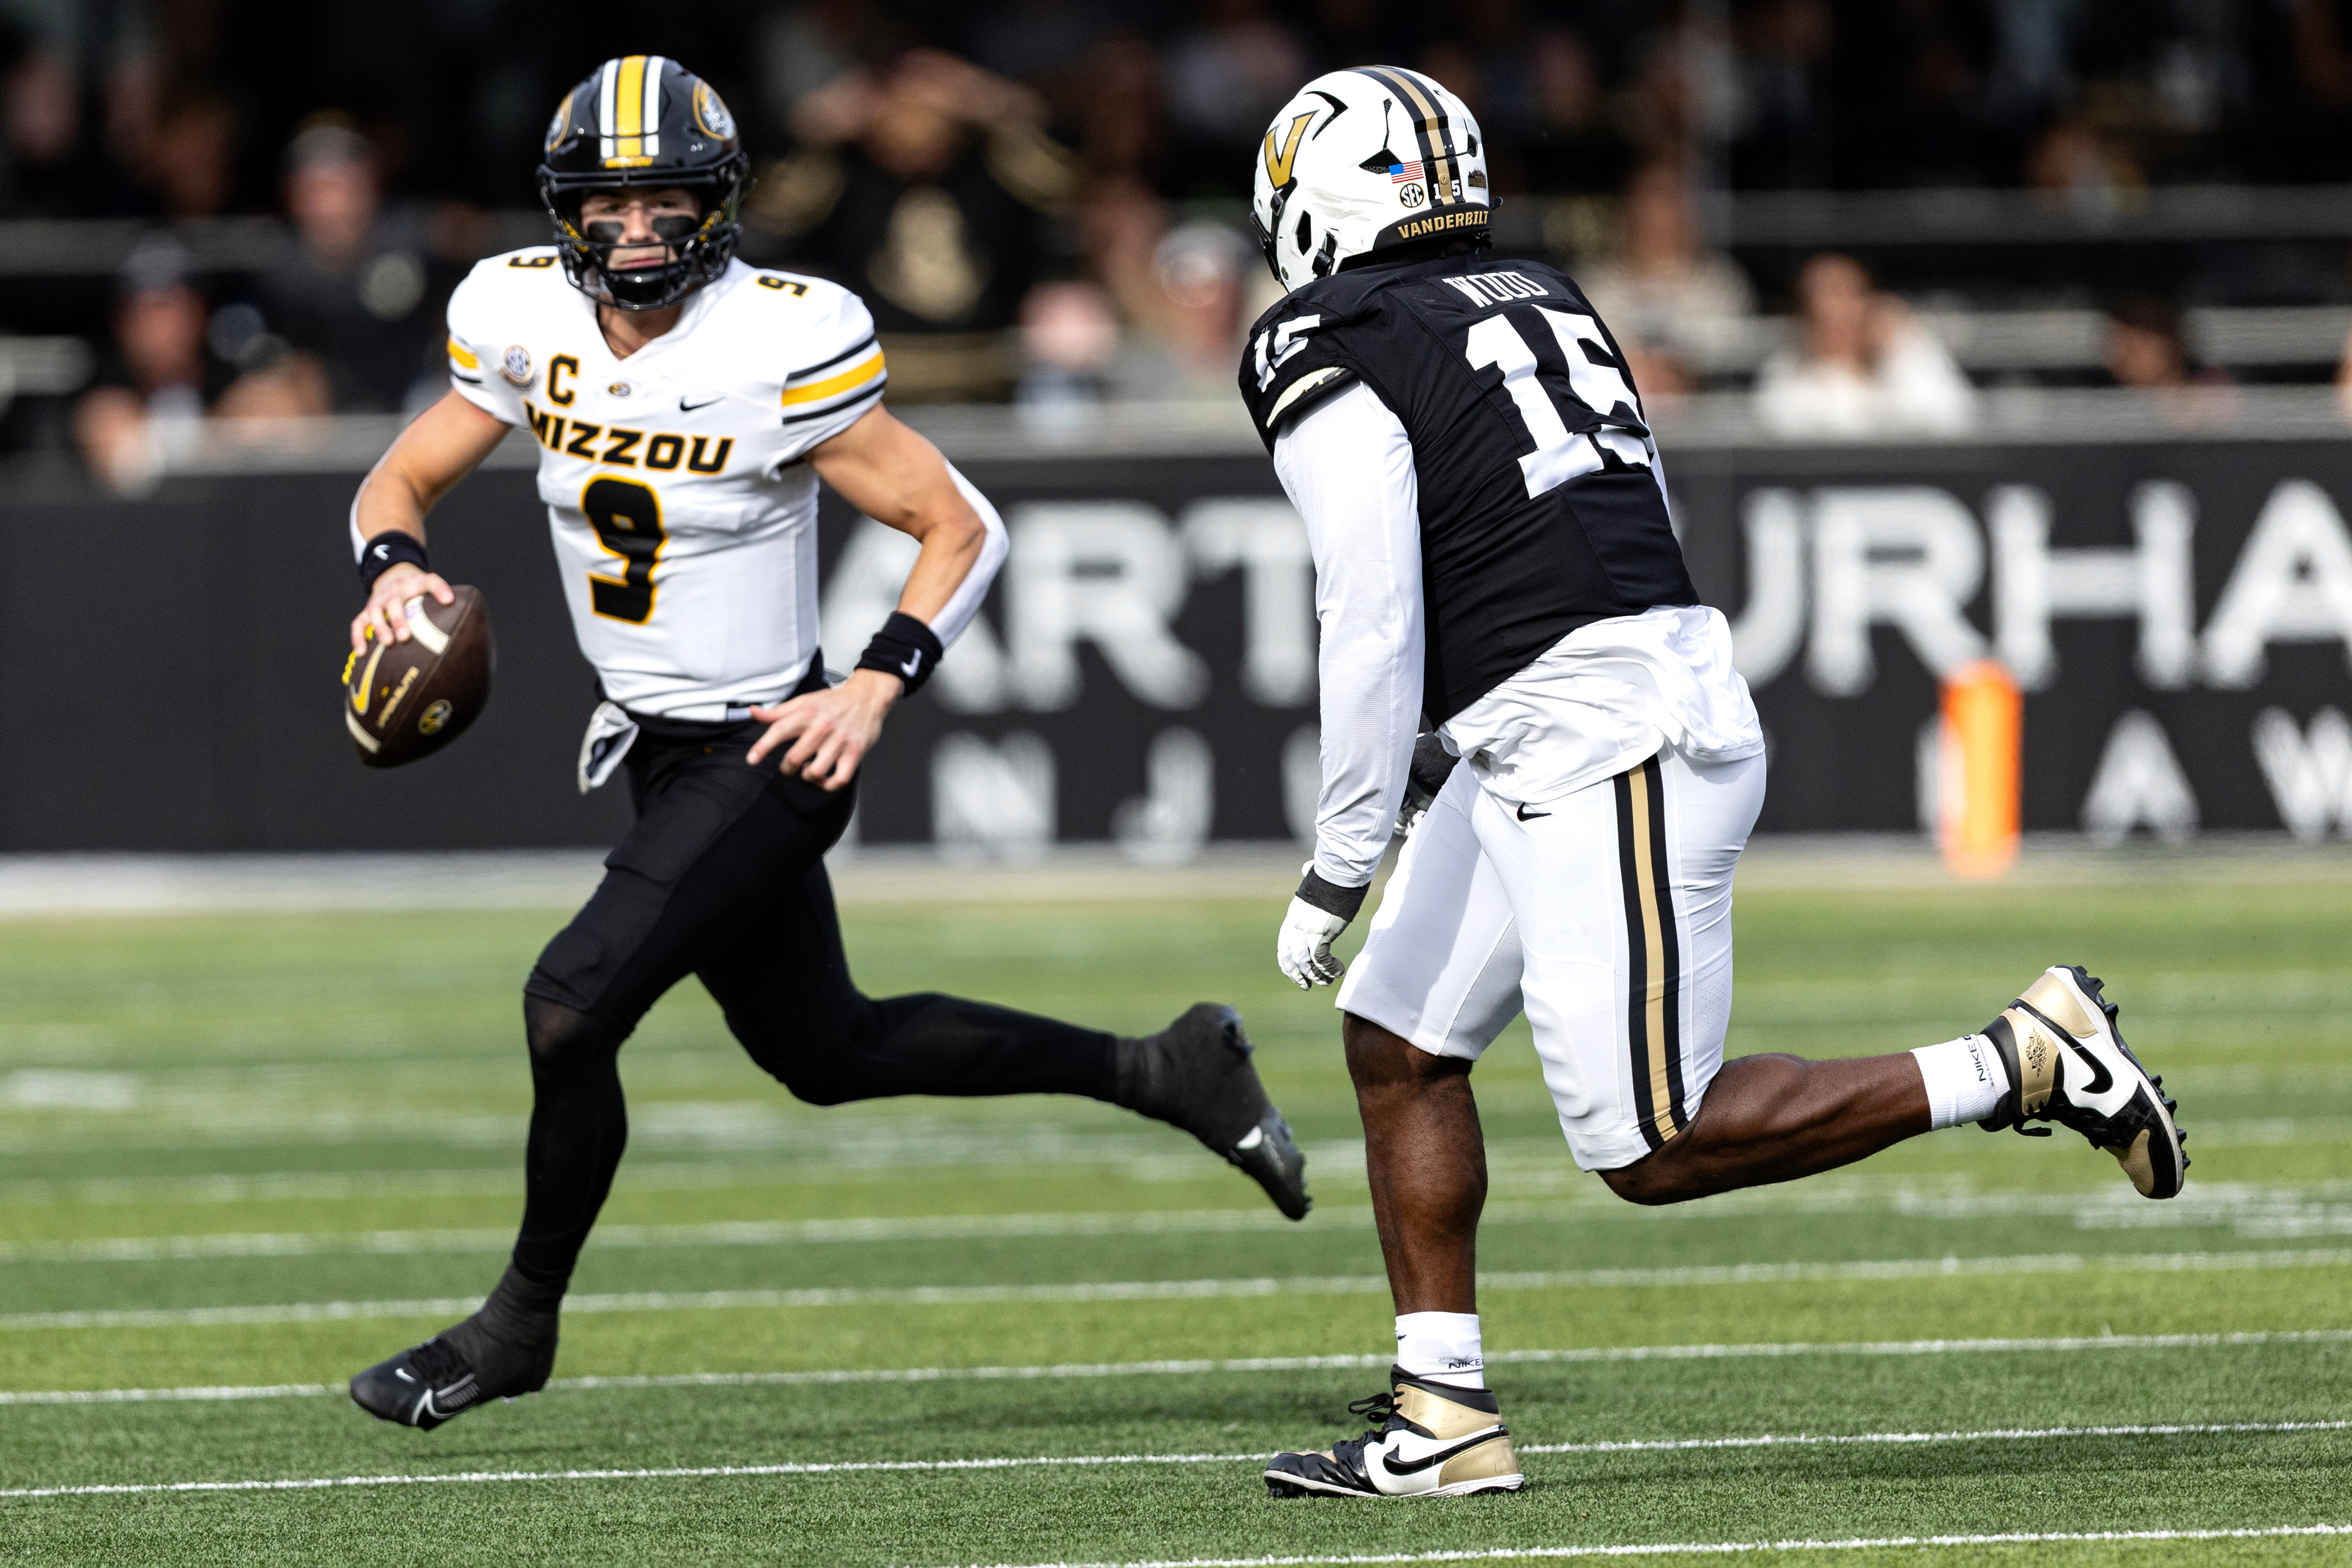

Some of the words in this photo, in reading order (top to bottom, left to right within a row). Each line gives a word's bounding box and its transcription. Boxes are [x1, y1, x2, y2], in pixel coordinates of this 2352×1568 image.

[1265, 109, 1321, 191] V
[1401, 183, 1423, 207] SEC
[1434, 180, 1461, 199] 15
[1397, 211, 1488, 239] VANDERBILT
[507, 255, 560, 269] 9
[757, 275, 809, 298] 9
[1442, 271, 1549, 308] WOOD
[1254, 314, 1321, 393] 15
[546, 353, 579, 407] C
[1465, 304, 1653, 499] 15
[522, 397, 736, 475] MIZZOU
[581, 474, 669, 626] 9
[1967, 1043, 1987, 1082] NIKE
[1448, 1358, 1481, 1369] NIKE
